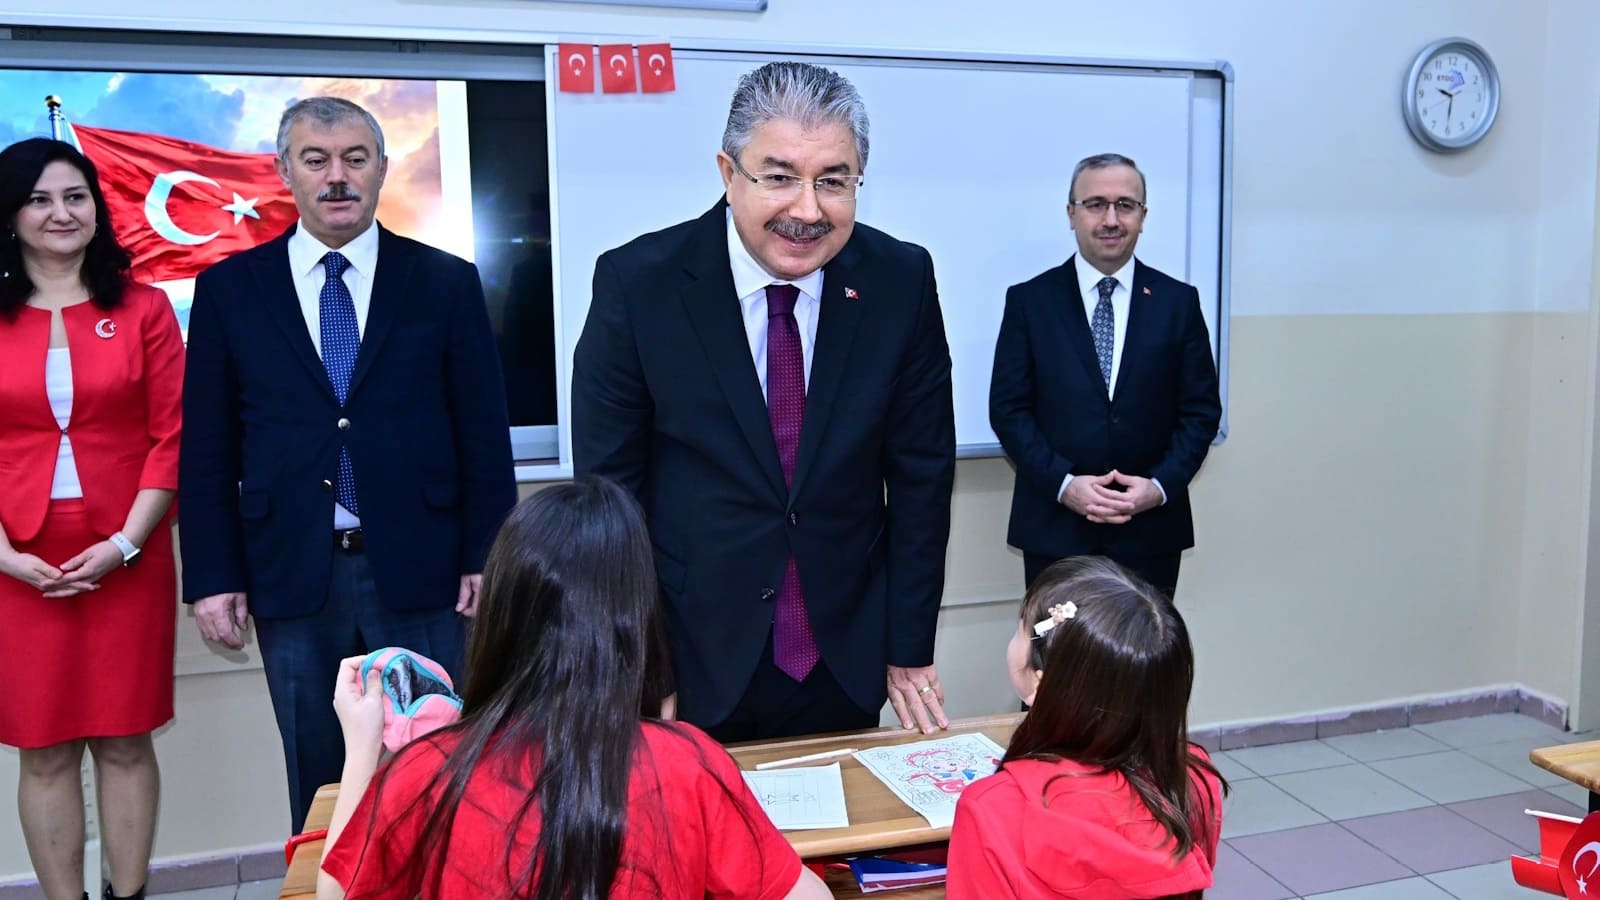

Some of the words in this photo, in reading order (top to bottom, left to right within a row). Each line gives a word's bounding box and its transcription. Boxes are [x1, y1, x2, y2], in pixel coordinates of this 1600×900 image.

[1435, 60, 1442, 69] 11
[1449, 56, 1458, 66] 12
[1423, 72, 1432, 81] 10
[1473, 75, 1479, 85] 2
[1418, 89, 1424, 98] 9
[1432, 120, 1438, 129] 7
[1459, 122, 1465, 132] 5
[1445, 126, 1450, 136] 6
